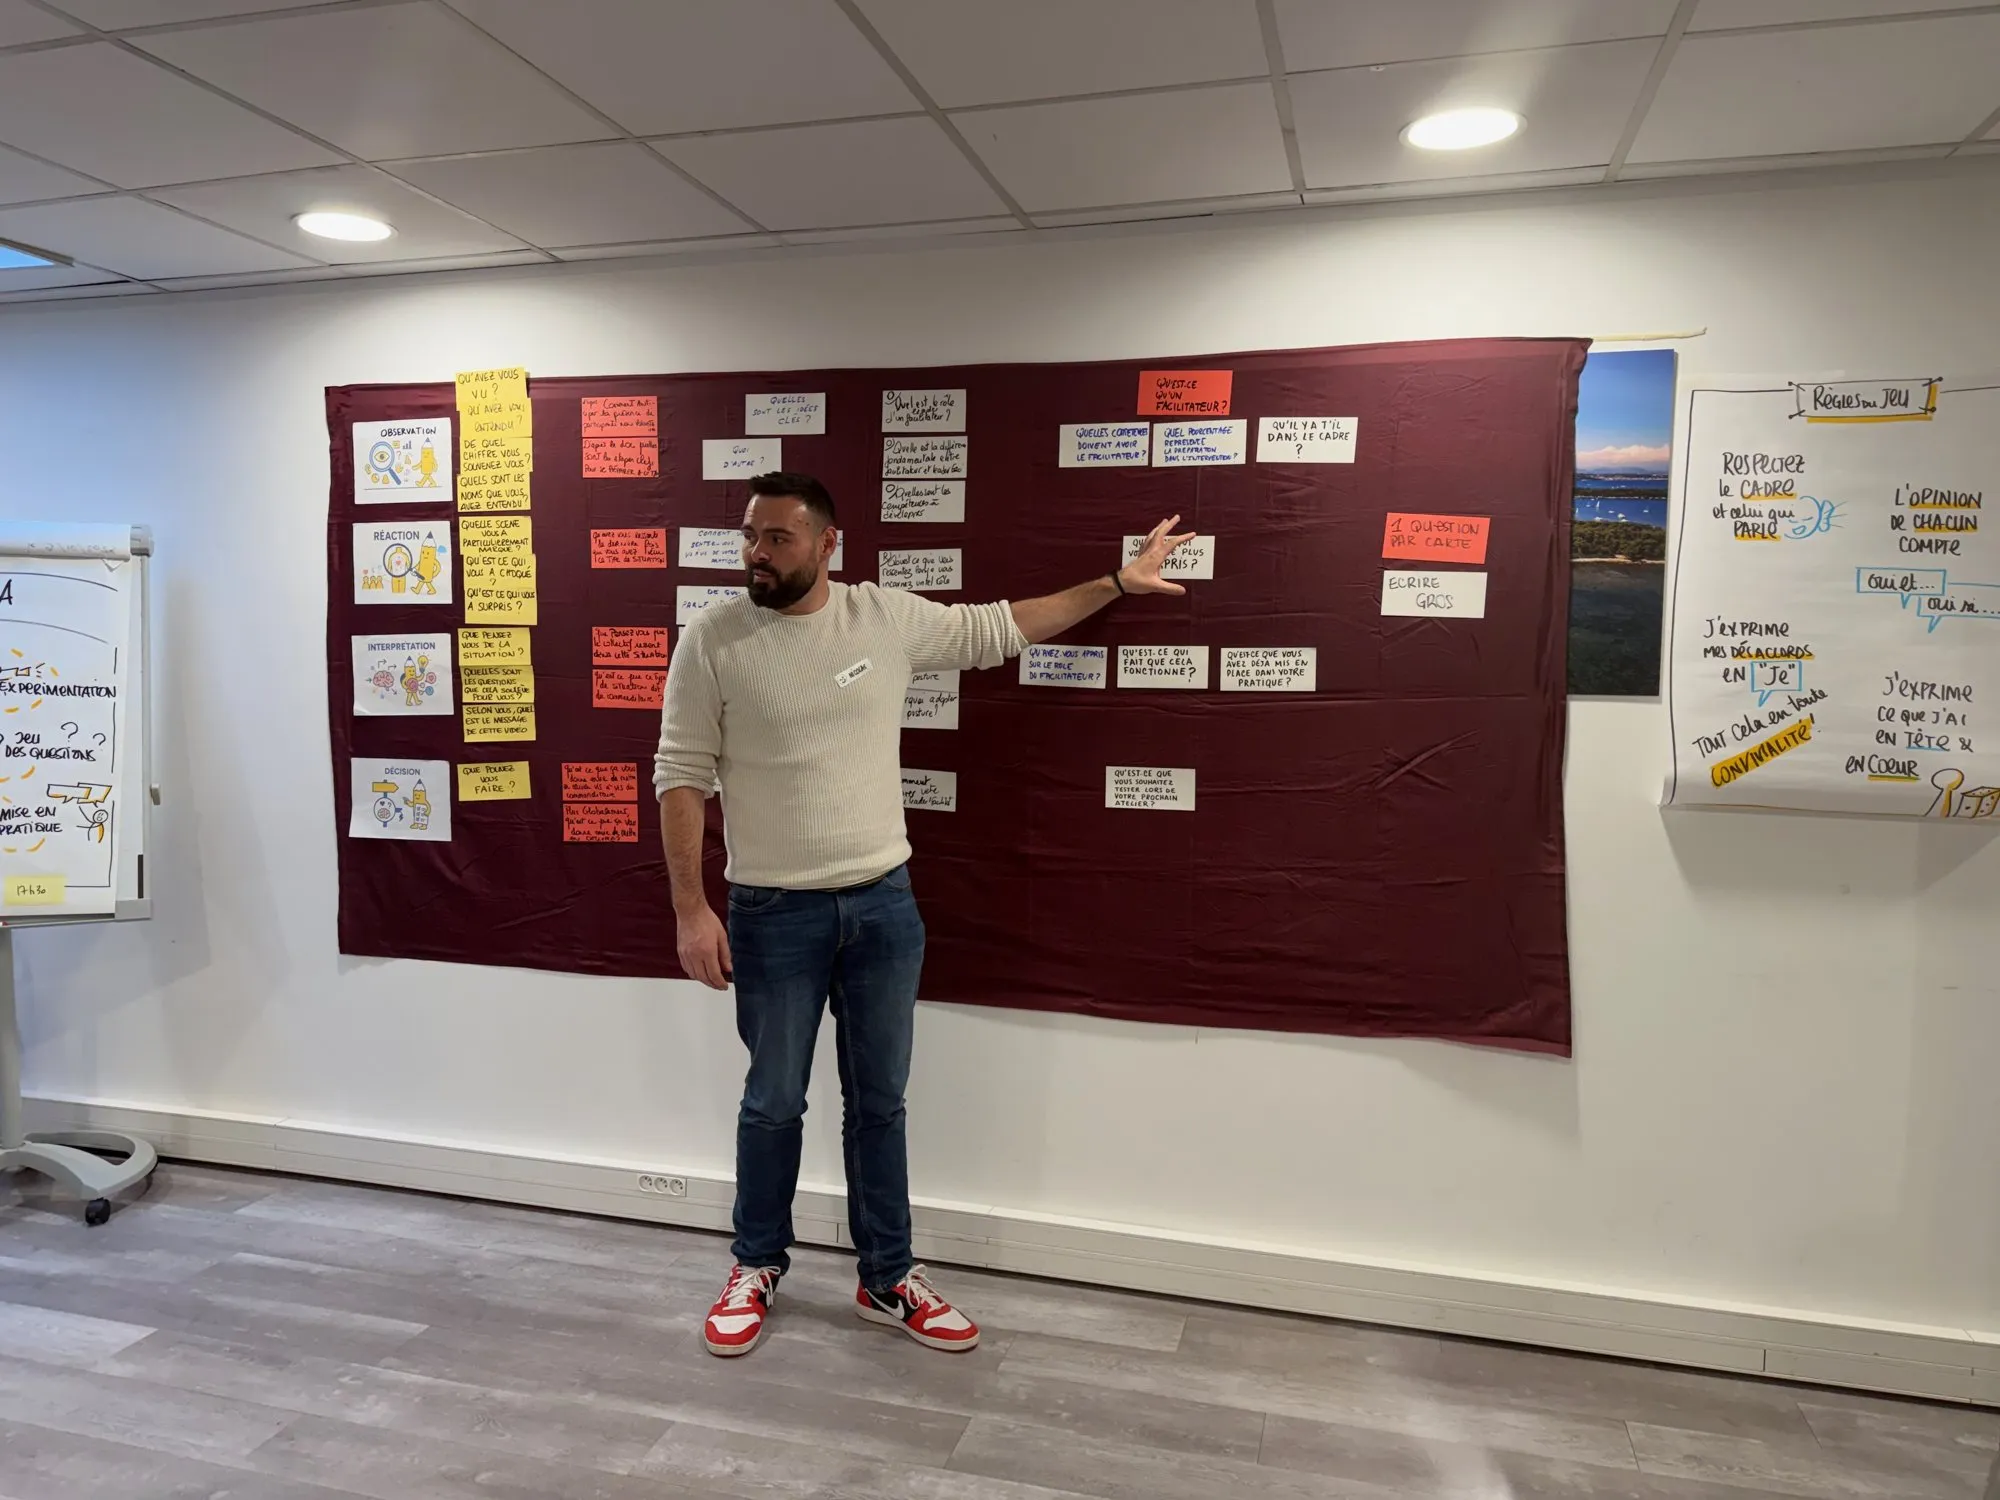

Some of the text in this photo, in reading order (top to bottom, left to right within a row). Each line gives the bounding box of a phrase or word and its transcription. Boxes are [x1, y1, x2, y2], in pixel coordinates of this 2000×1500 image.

[499, 369, 519, 380] VOUS
[1156, 391, 1183, 400] QU'UN
[1156, 401, 1219, 413] FACILITATEUR
[1272, 419, 1300, 431] QU'IL
[1302, 421, 1308, 430] Y
[1310, 421, 1317, 430] A
[380, 427, 437, 438] OBSERVATION
[1075, 428, 1109, 439] QUELLES
[1164, 428, 1185, 439] QUEL
[1267, 431, 1351, 442] DANS LE CADRE
[464, 438, 506, 449] DE QUEL
[1078, 440, 1137, 450] DOIVENT AVOIR
[500, 448, 520, 458] VOUS
[1077, 452, 1140, 461] LE FACILITATEUR
[463, 460, 525, 472] SOUVENEZ VOUS
[1719, 478, 1733, 498] le
[1712, 503, 1796, 528] et celui qui
[461, 520, 492, 530] QUELLE
[1391, 517, 1480, 535] 1 QUESTION
[1914, 514, 1978, 531] CHACUN
[374, 530, 420, 541] RÉACTION
[1391, 535, 1473, 549] PAR CARTE
[1182, 548, 1204, 557] PLUS
[498, 557, 508, 566] CE
[512, 557, 526, 567] QUI
[1160, 557, 1188, 570] PRIS
[466, 569, 484, 577] VOUS
[489, 568, 495, 577] A
[1388, 576, 1441, 590] ECRIRE
[467, 588, 535, 600] QU'EST CE QUI VOUS
[468, 602, 474, 611] A
[1415, 593, 1454, 610] GROS
[462, 631, 513, 640] QUE PENSEZ
[463, 651, 516, 659] SITUATION
[1173, 648, 1189, 658] QUI
[1262, 650, 1278, 659] QUE
[1282, 650, 1302, 658] VOUS
[1029, 661, 1041, 669] SUR
[1123, 658, 1193, 667] FAIT QUE CELA
[1226, 660, 1247, 668] AVEZ
[1274, 660, 1290, 668] MIS
[1295, 660, 1309, 668] EN
[1040, 672, 1094, 681] FACILITATEUR
[1123, 666, 1186, 677] FONCTIONNE
[1227, 668, 1305, 677] PLACE DANS VOTRE
[1238, 678, 1283, 689] PRATIQUE
[1768, 710, 1793, 725] en
[1787, 688, 1829, 712] toute
[384, 766, 421, 776] DÉCISION
[463, 765, 515, 776] QUE POUVEZ
[1156, 770, 1173, 778] QUE
[1135, 778, 1174, 786] SOUHAITEZ
[1144, 786, 1163, 794] LORS
[1141, 794, 1178, 802] PROCHAIN
